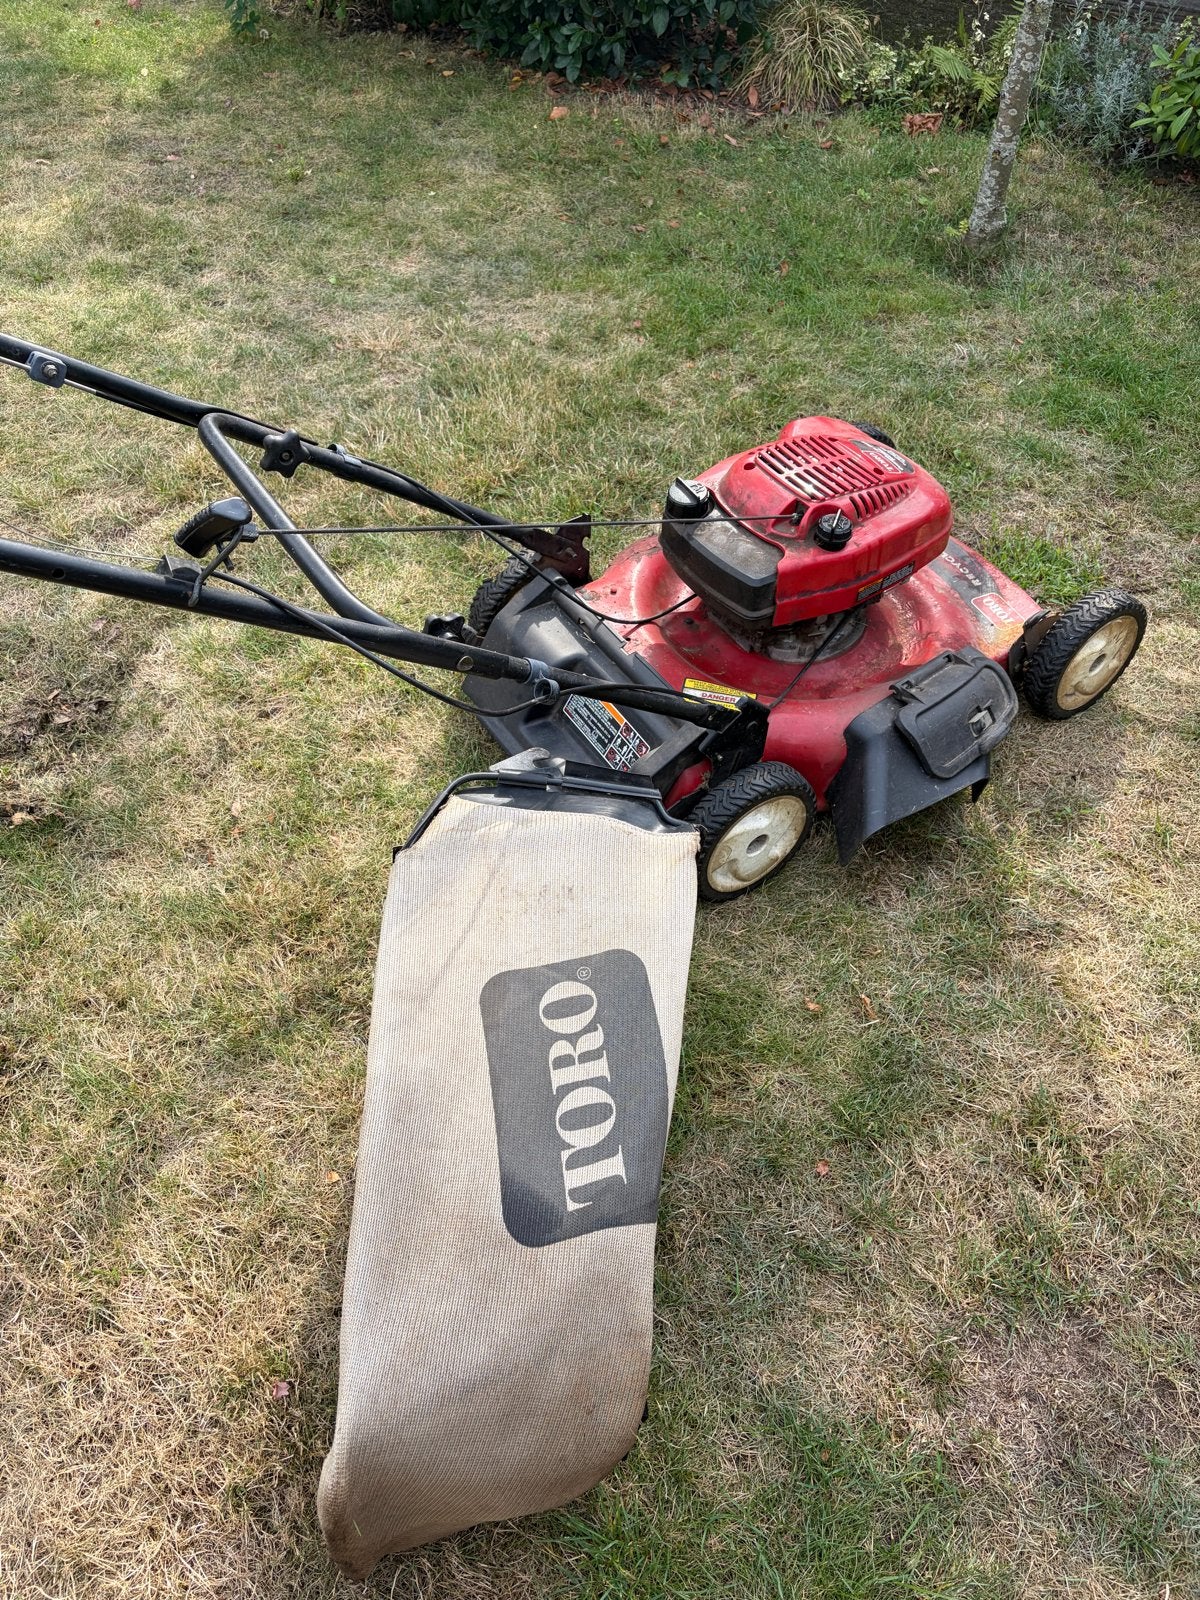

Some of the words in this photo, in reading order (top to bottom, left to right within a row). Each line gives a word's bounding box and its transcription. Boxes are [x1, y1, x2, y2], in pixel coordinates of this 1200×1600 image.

[941, 551, 982, 586] RECYCL
[982, 597, 1015, 624] TORO
[701, 692, 736, 703] DANGER
[538, 980, 628, 1212] TORO
